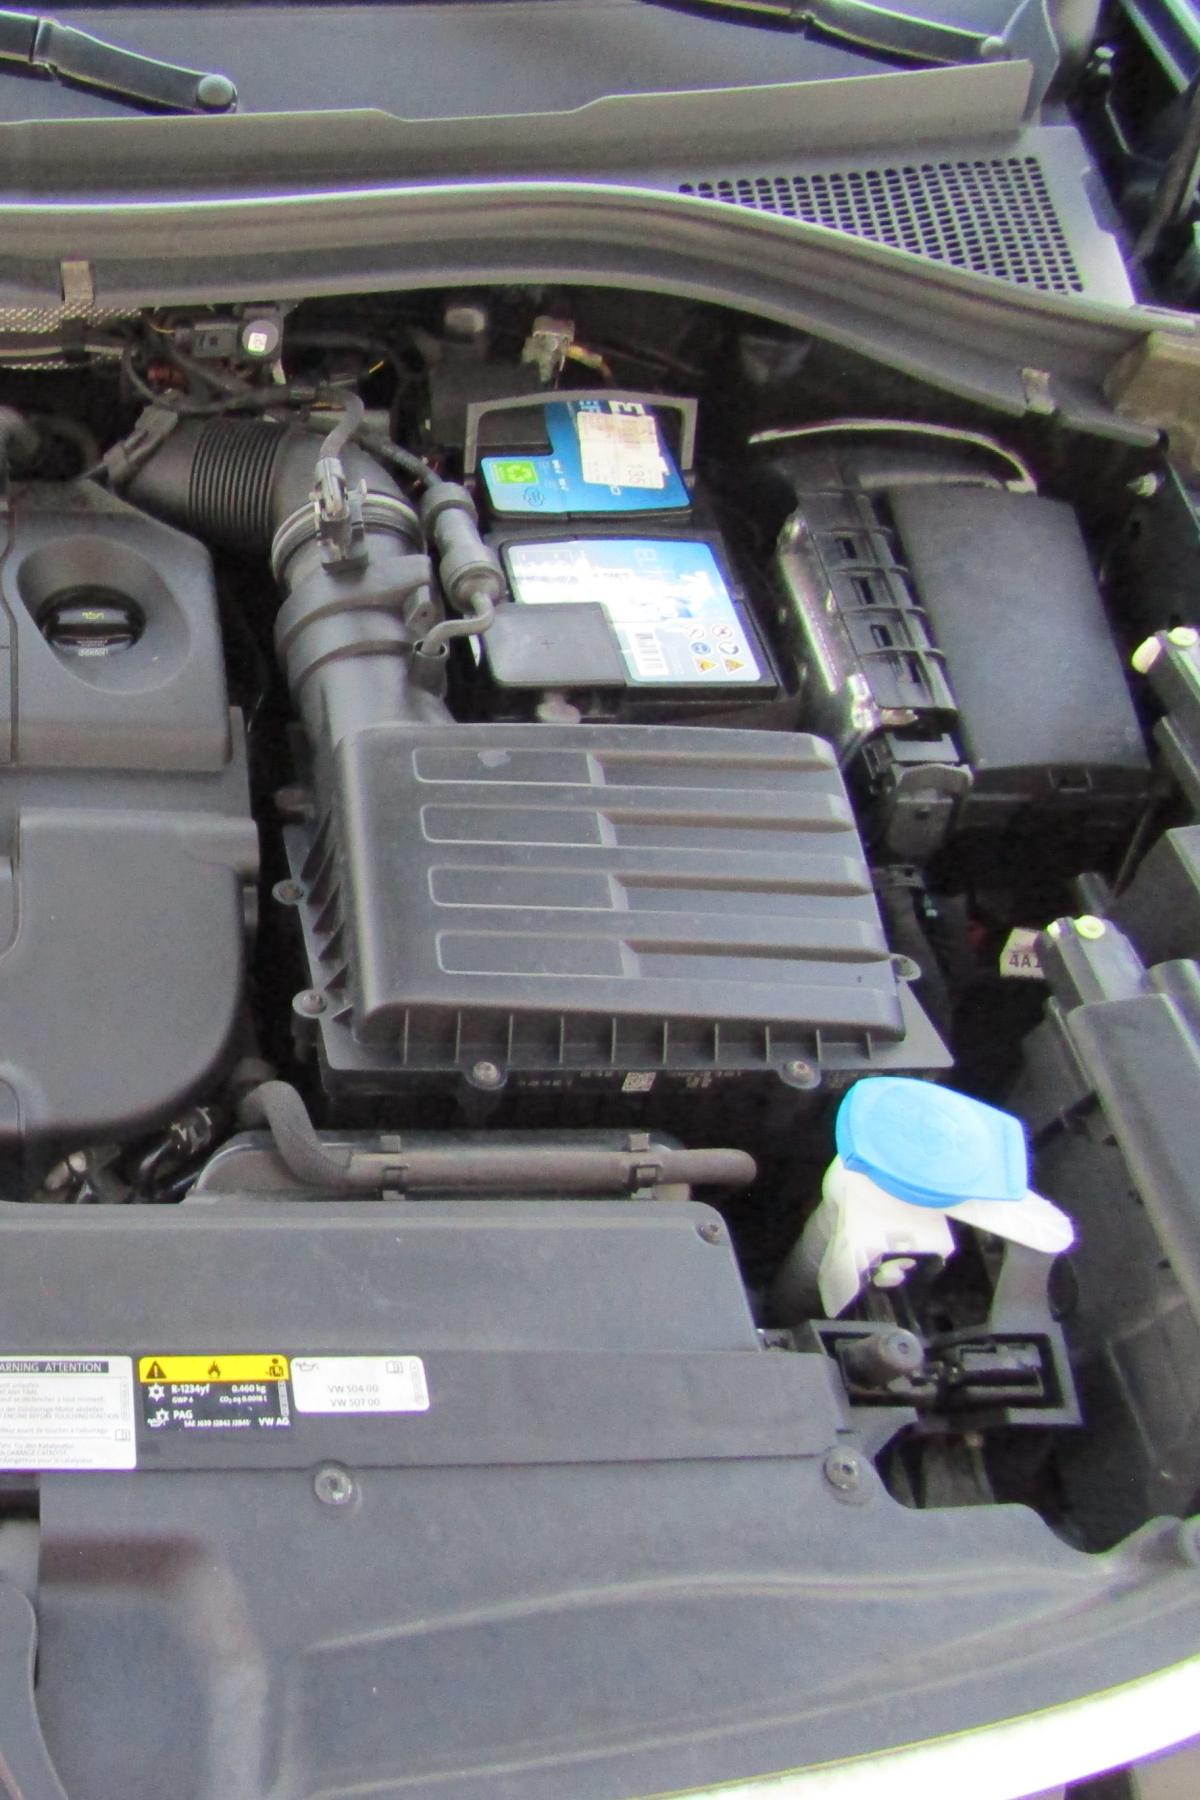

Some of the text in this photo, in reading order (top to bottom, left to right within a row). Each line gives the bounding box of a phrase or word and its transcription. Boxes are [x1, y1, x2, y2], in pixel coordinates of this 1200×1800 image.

[44, 1362, 102, 1372] ATTENTION
[171, 1383, 267, 1396] R-1234yf 0.460 kg
[328, 1385, 344, 1393] VW
[366, 1384, 379, 1393] 00
[331, 1398, 346, 1407] VW
[368, 1398, 380, 1407] 00
[173, 1410, 193, 1419] PAG
[258, 1417, 274, 1427] VW
[275, 1417, 290, 1426] AG
